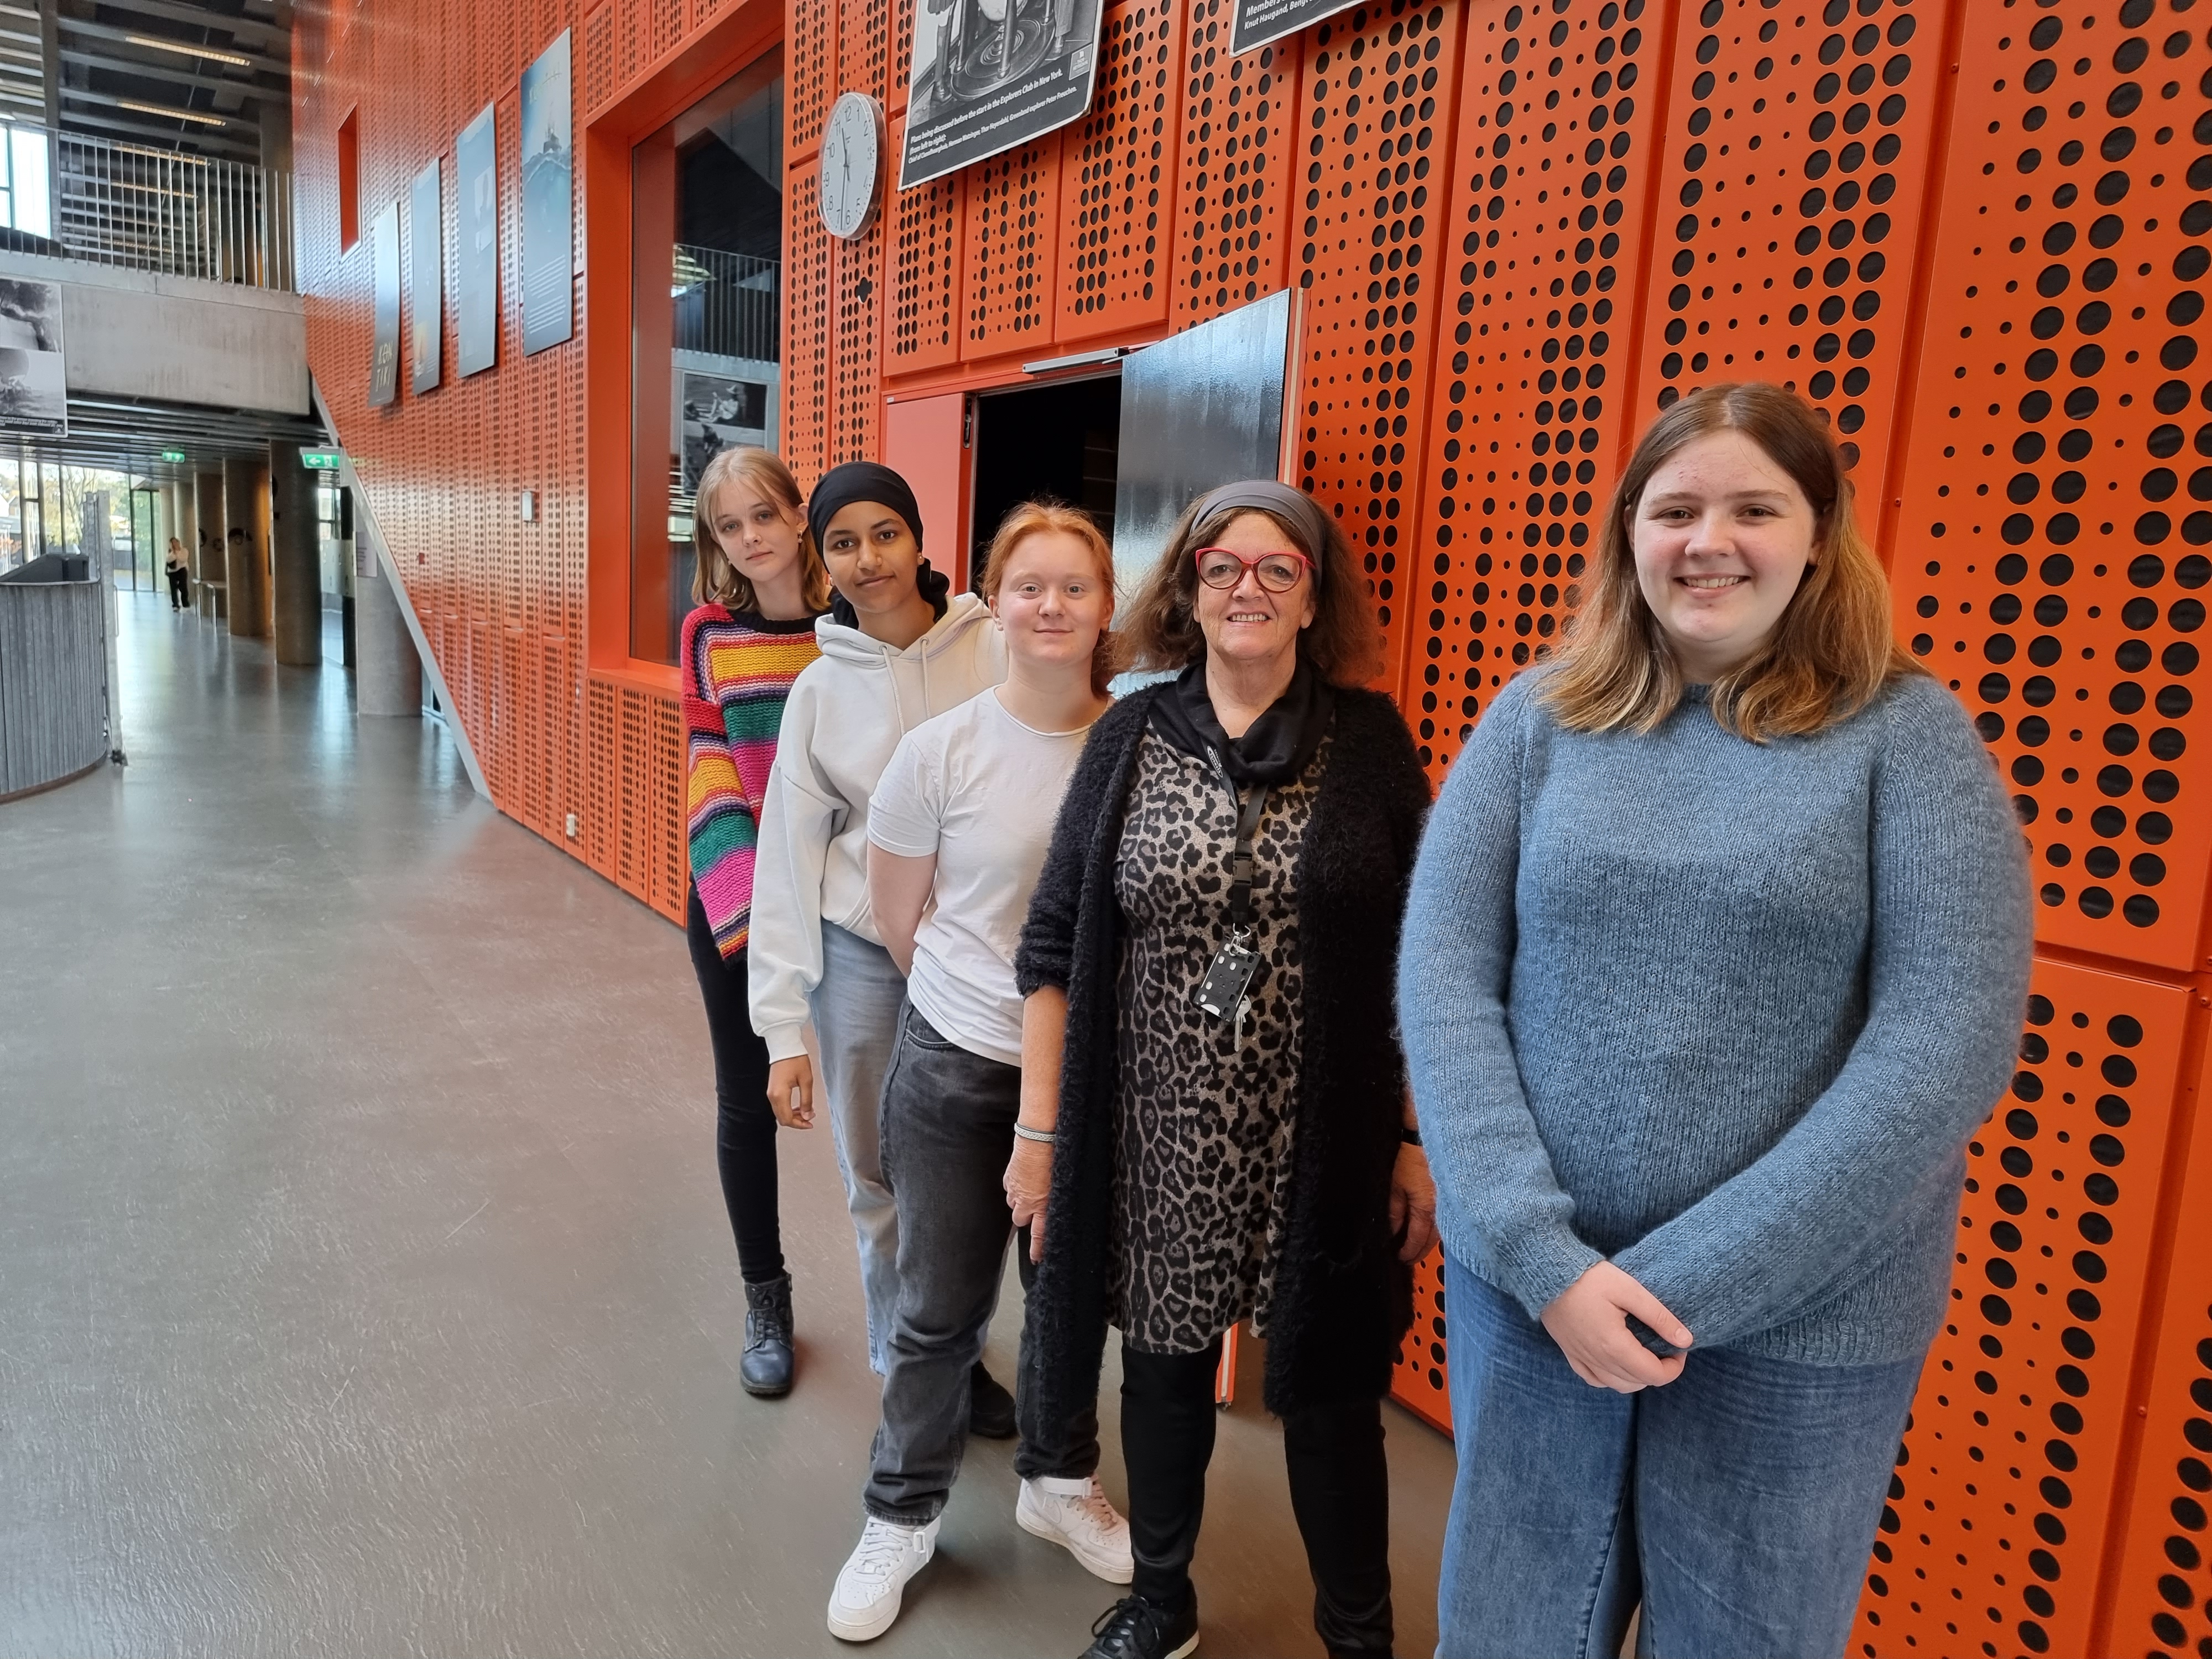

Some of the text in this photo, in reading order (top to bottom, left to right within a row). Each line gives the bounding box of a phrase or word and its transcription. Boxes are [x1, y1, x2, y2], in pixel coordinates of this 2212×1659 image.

[1244, 17, 1259, 30] Knut
[1259, 3, 1288, 20] Haugand,
[910, 134, 922, 144] Plans
[922, 129, 933, 139] being
[933, 118, 954, 134] discussed
[954, 114, 968, 125] before
[976, 105, 987, 116] start
[987, 102, 992, 111] in
[1000, 89, 1022, 104] Explorers
[1022, 82, 1034, 94] Club
[1034, 80, 1039, 88] in
[1039, 75, 1050, 86] New
[1051, 68, 1063, 80] York.
[1030, 100, 1046, 112] explorer
[1046, 95, 1057, 105] Peter
[844, 106, 852, 122] 12
[857, 107, 860, 122] 1
[835, 120, 841, 137] 11
[864, 120, 868, 137] 2
[826, 142, 835, 159] 10
[825, 171, 830, 187] 9
[829, 195, 833, 211] 8
[836, 208, 841, 225] 7
[846, 209, 851, 225] 6
